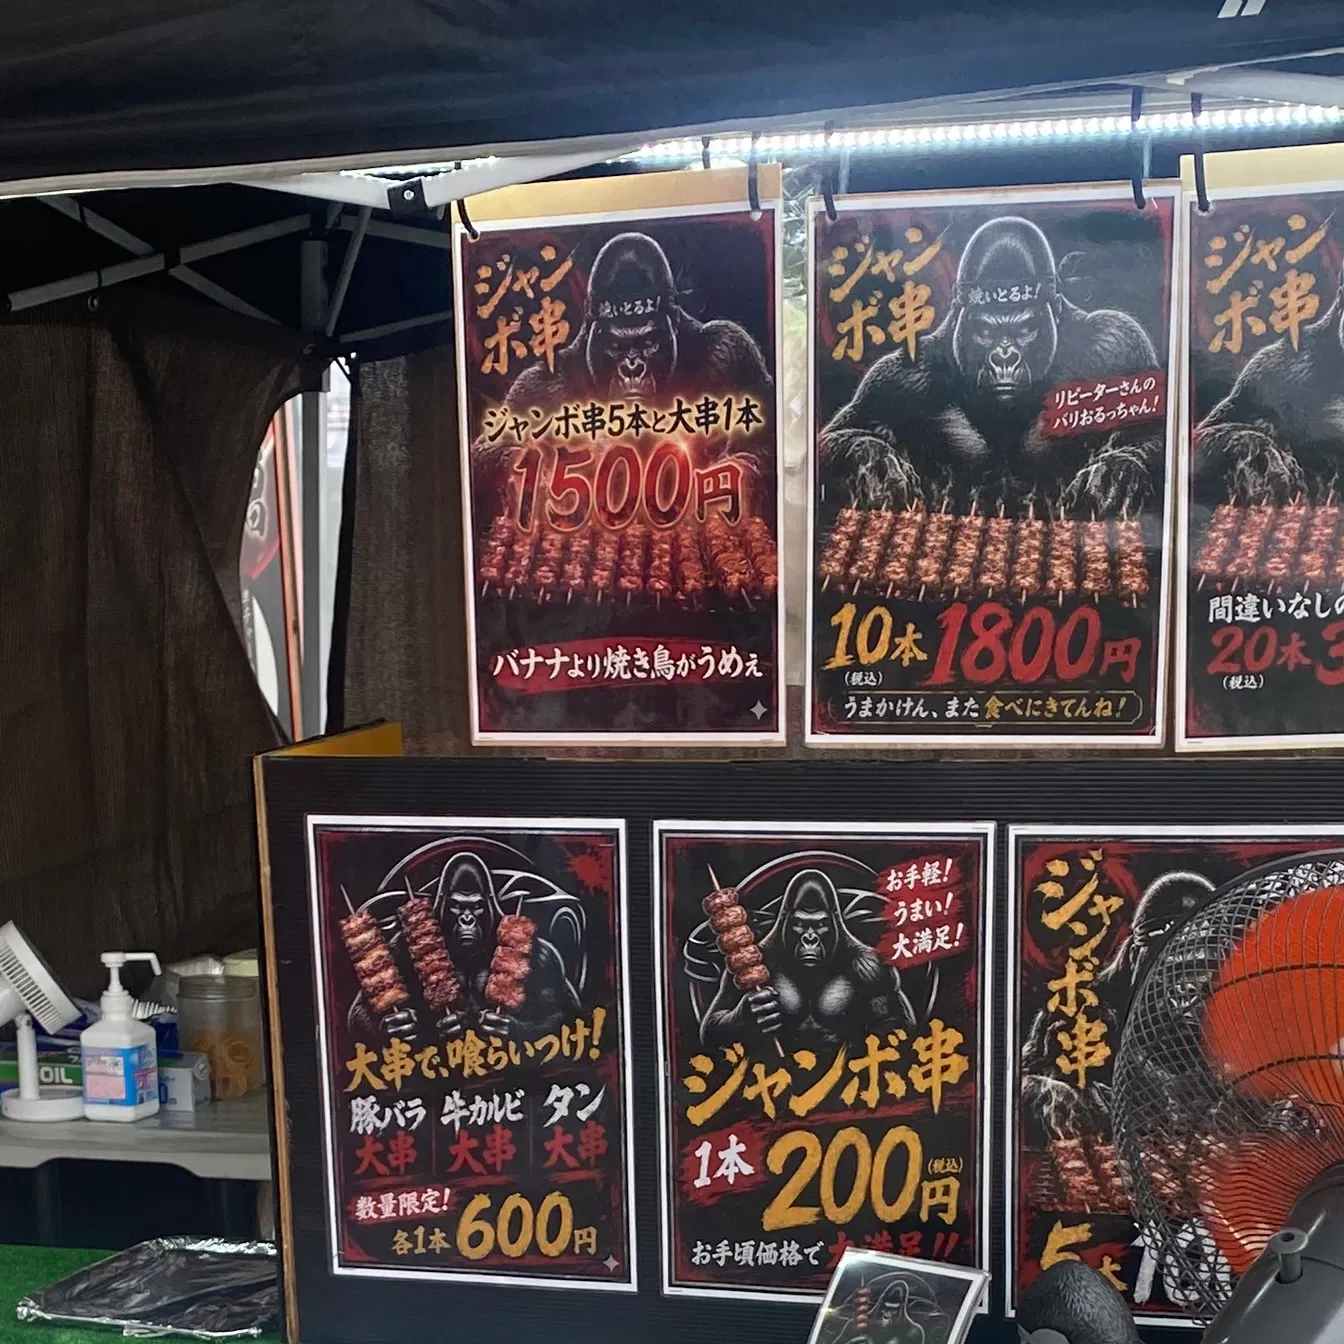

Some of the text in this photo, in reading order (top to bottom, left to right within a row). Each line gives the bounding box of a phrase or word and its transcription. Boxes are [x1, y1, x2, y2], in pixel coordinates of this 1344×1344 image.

[483, 397, 764, 443] ジャンボ串5本と大串1本
[1054, 376, 1157, 409] リピーターさんの
[512, 443, 744, 534] 1500円
[820, 600, 1143, 686] 10本 1800円
[1205, 625, 1313, 676] 20本
[40, 1066, 74, 1085] OIL
[683, 1018, 970, 1127] ジャンボ串
[349, 1082, 607, 1136] 豚バラ 牛カルビ タン
[353, 1119, 609, 1177] 大串 大串 大串
[692, 1124, 961, 1233] 1本 200円
[391, 1189, 598, 1261] 各1本 600円
[691, 1239, 826, 1269] お手頃価格で
